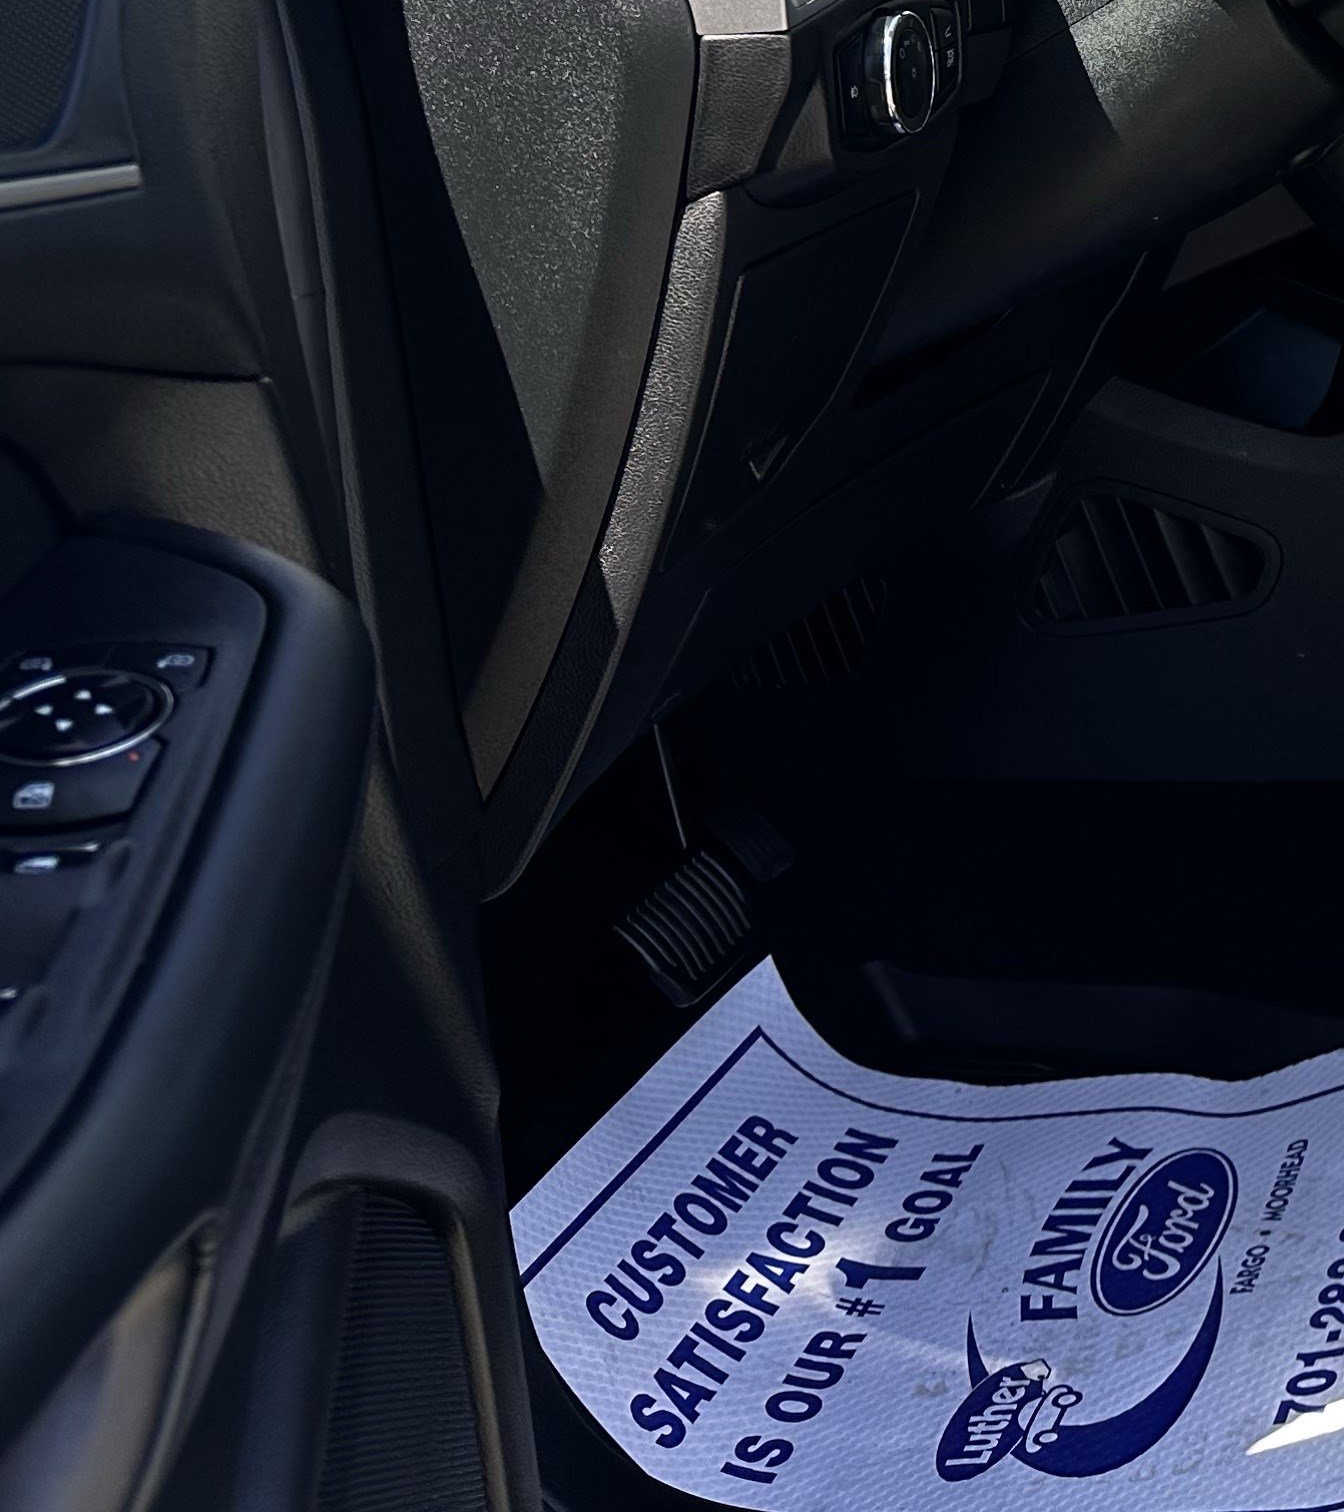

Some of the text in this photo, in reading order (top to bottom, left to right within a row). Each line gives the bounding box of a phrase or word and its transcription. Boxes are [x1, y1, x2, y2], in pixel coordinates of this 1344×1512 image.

[585, 1115, 799, 1341] CUSTOMER
[629, 1127, 899, 1449] SATISFACTION
[1020, 1136, 1154, 1322] FAMILY
[1112, 1180, 1216, 1281] Ford
[1230, 1138, 1309, 1295] FARGO MOORHEAD
[719, 1435, 794, 1484] IS
[764, 1330, 868, 1423] OUR
[884, 1143, 985, 1242] GOAL
[945, 1376, 1031, 1467] Luther
